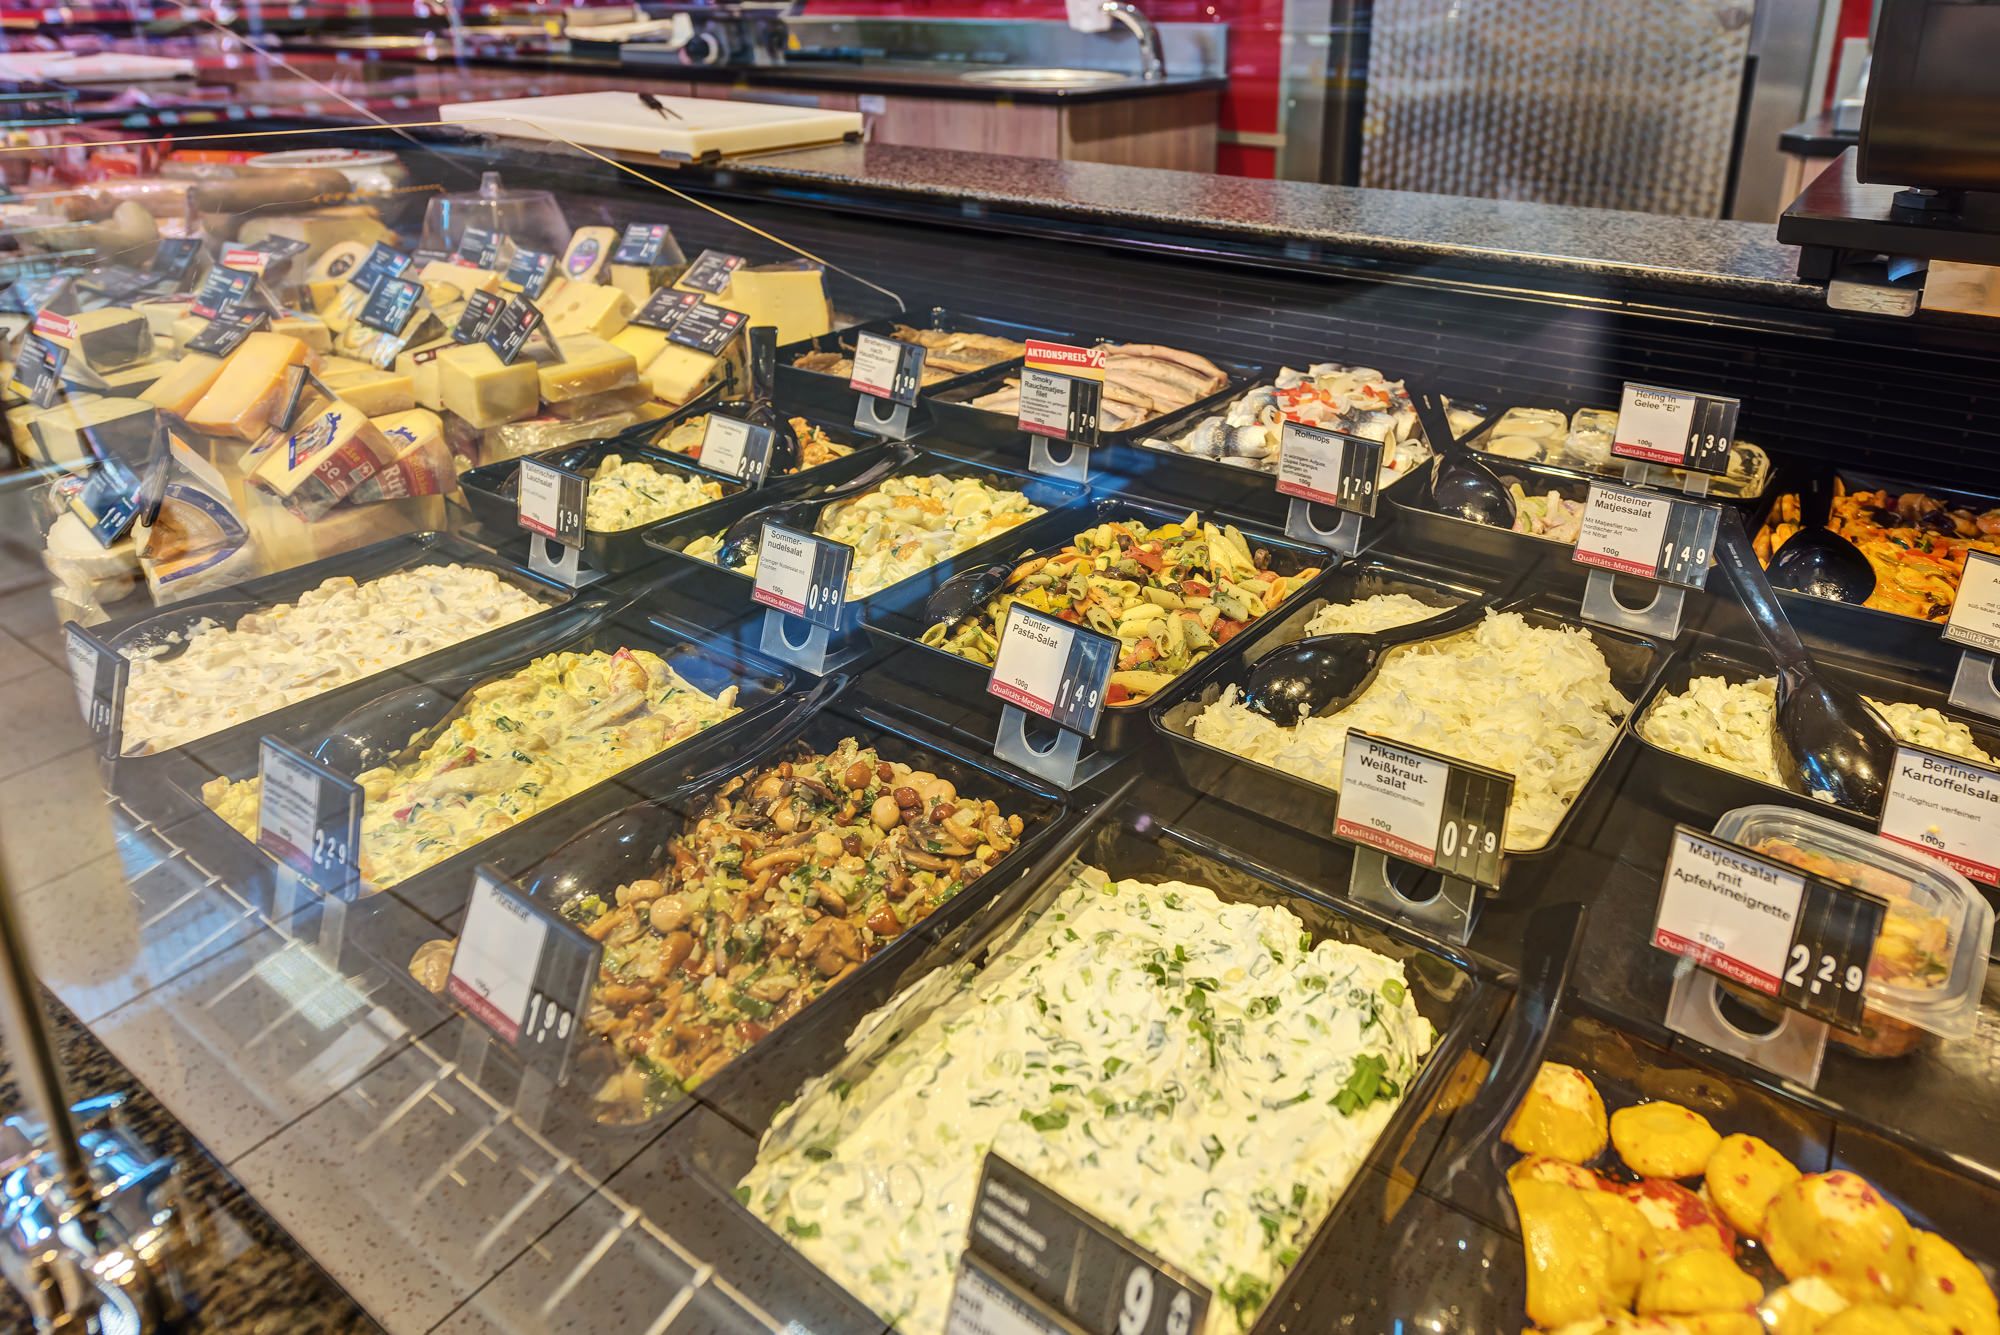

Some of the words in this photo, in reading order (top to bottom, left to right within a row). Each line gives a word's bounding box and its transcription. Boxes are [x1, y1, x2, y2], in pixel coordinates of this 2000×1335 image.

[1027, 348, 1087, 363] AKTIONSPREIS
[895, 373, 916, 395] 1.19
[1024, 380, 1067, 396] Rauchmatjes-
[1032, 374, 1053, 386] Smoky
[1634, 399, 1661, 410] Gelee
[1636, 390, 1666, 404] Hering
[1069, 411, 1096, 433] 1.79
[1294, 429, 1331, 445] Rollmops
[1637, 439, 1653, 448] 100g
[1690, 433, 1728, 457] 1.39
[1615, 445, 1682, 463] Qualitäts-Metzgerei
[737, 456, 762, 480] 2.99
[1298, 478, 1311, 488] 100g
[1343, 476, 1372, 500] 1.79
[1594, 499, 1652, 519] Matjessalat
[1599, 490, 1652, 508] Holsteiner
[559, 509, 579, 533] 1.39
[767, 540, 803, 558] nudelsalat
[771, 530, 802, 546] Sommer-
[1602, 546, 1620, 557] 100g
[1664, 542, 1706, 572] 1.49
[1577, 553, 1655, 577] Qualitäts-Metzgerei
[772, 585, 784, 595] 100g
[809, 583, 838, 612] 0.99
[1022, 615, 1051, 633] Bunter
[1012, 623, 1058, 649] Pasta-Salat
[1948, 626, 2000, 648] Qualitäts-M
[1015, 677, 1029, 690] 100g
[992, 683, 1052, 715] Qualitäts-Metzgerei
[1059, 678, 1098, 712] 1.49
[1369, 744, 1421, 769] Pikanter
[1360, 755, 1429, 785] Weißkraut-
[1922, 757, 1984, 784] Berliner
[1376, 773, 1407, 791] salat
[1902, 766, 2000, 803] Kartoffelsala
[1892, 790, 1905, 800] mit
[1907, 795, 1939, 810] Joghurt
[1940, 803, 1981, 822] verfeinert
[1370, 817, 1392, 832] 100g
[314, 829, 347, 870] 2.29
[1339, 824, 1433, 863] Qualitäts-Metzgerei
[1442, 820, 1497, 857] 0.79
[1919, 833, 1946, 849] 100g
[1688, 841, 1779, 885] Matjessalat
[1716, 871, 1744, 888] mit
[1673, 866, 1792, 922] Apfelvineigrette
[1784, 943, 1863, 995] 2.29
[526, 992, 572, 1044] 1.99
